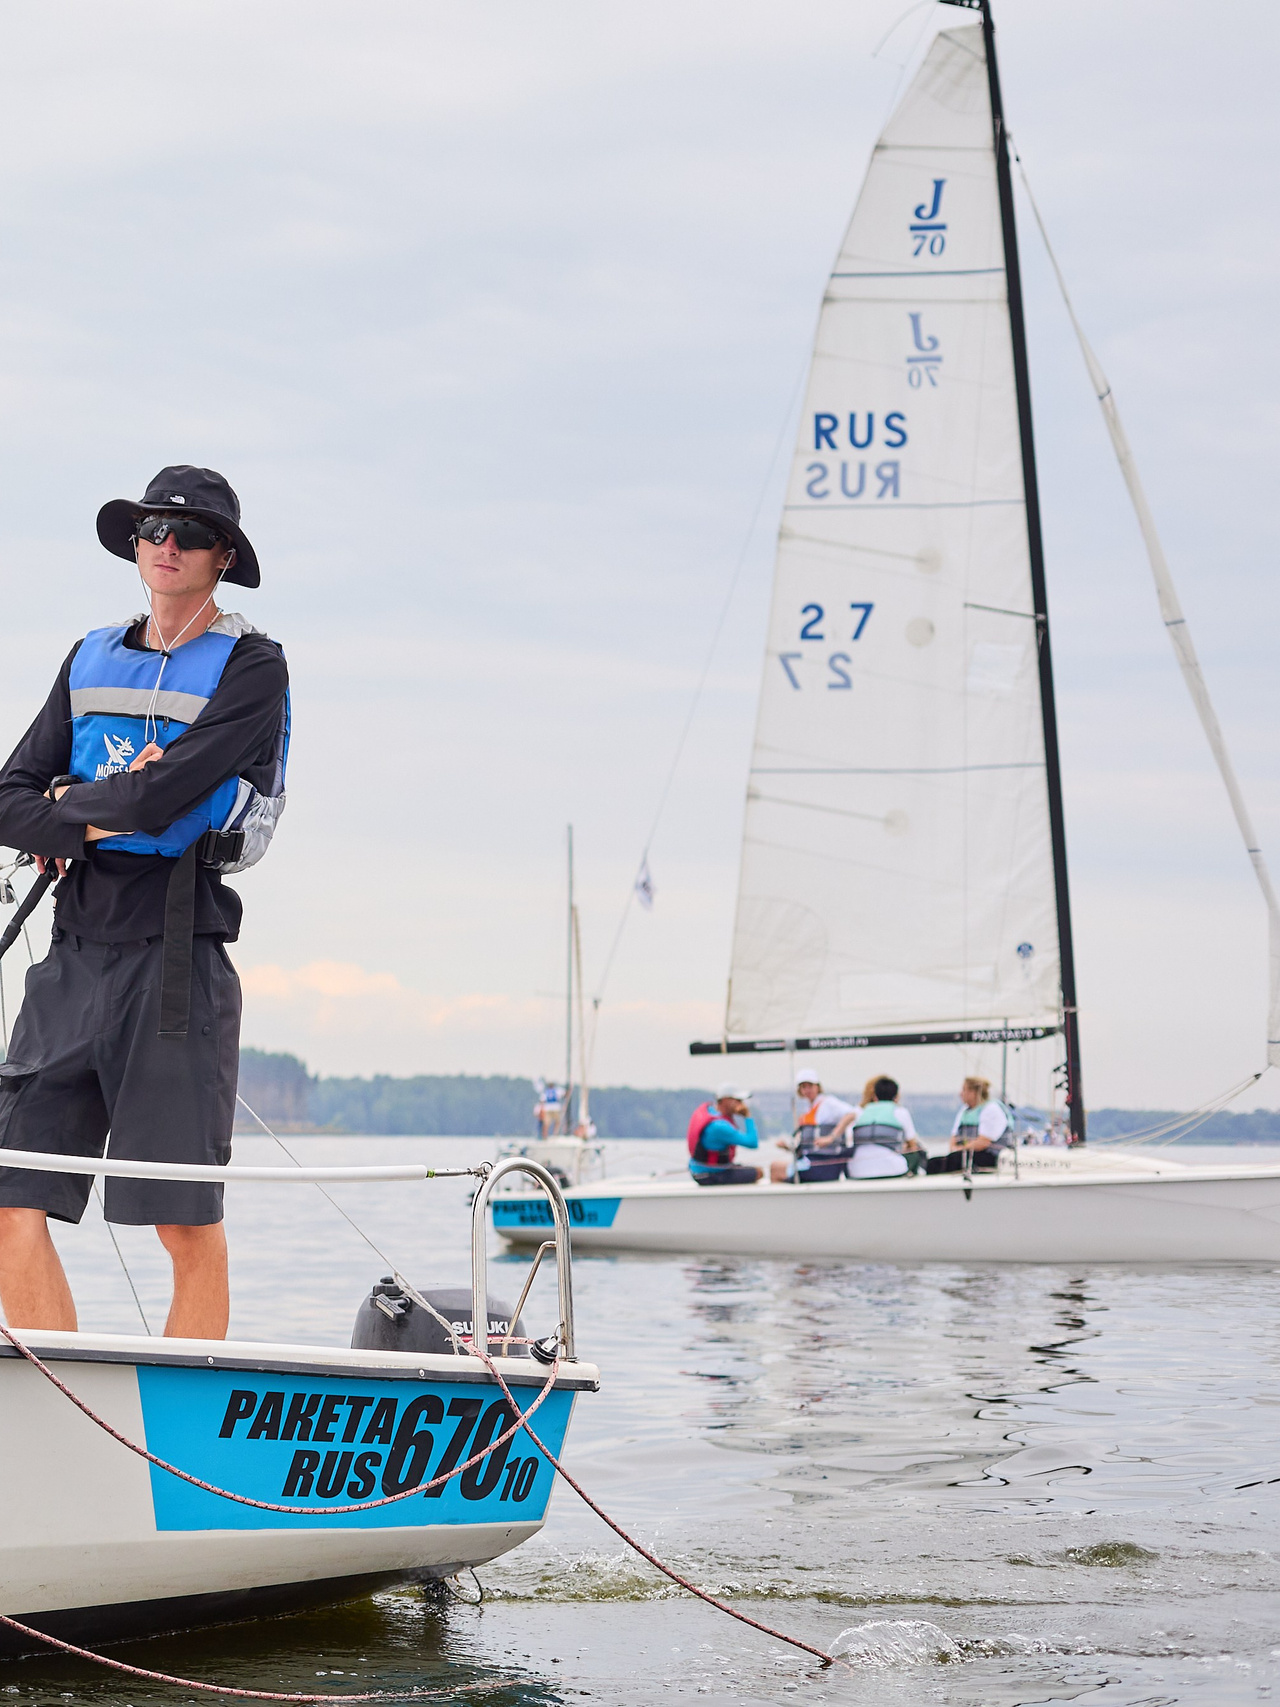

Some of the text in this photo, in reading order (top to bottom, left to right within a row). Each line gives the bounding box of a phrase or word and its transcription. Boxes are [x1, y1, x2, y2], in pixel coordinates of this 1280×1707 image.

[914, 178, 947, 220] J
[912, 233, 946, 258] 70
[814, 411, 908, 450] RUS
[451, 1321, 510, 1334] SUUKI
[281, 1449, 383, 1499] RUS
[499, 1455, 539, 1502] 10
